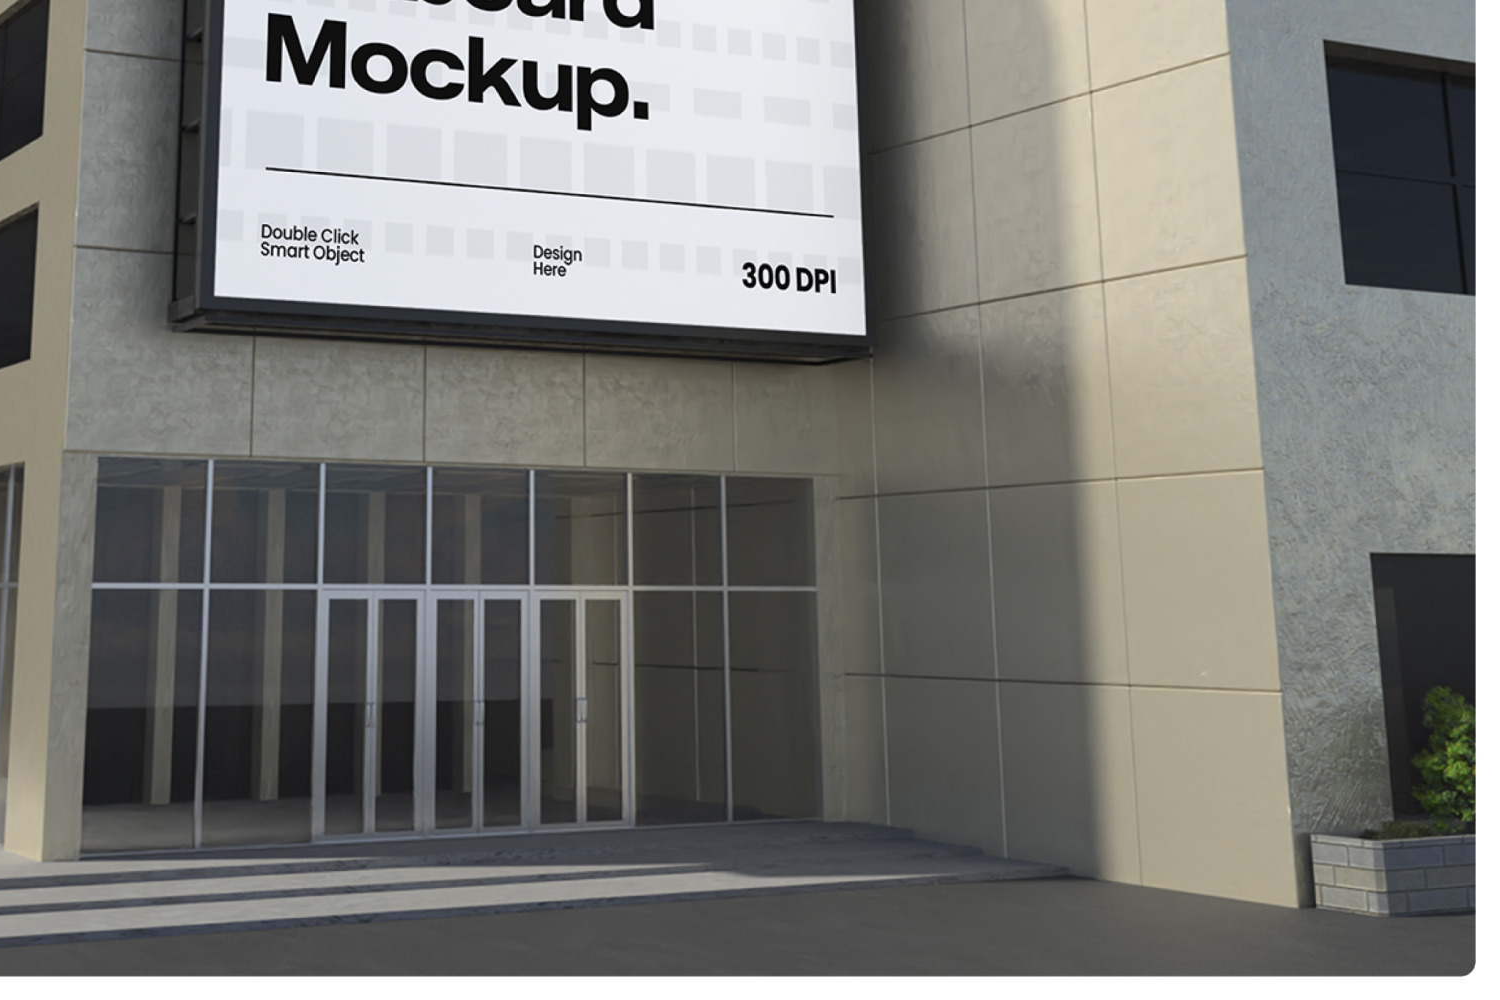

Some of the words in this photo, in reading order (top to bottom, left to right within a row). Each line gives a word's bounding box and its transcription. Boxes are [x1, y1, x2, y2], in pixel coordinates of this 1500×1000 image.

[265, 12, 650, 132] Mockup.
[261, 223, 318, 243] Double
[320, 228, 360, 246] Click
[260, 241, 311, 260] Smart
[312, 244, 366, 267] Object
[533, 244, 583, 267] Design
[533, 261, 567, 278] Here
[741, 261, 791, 291] 300
[795, 266, 837, 294] DPI
